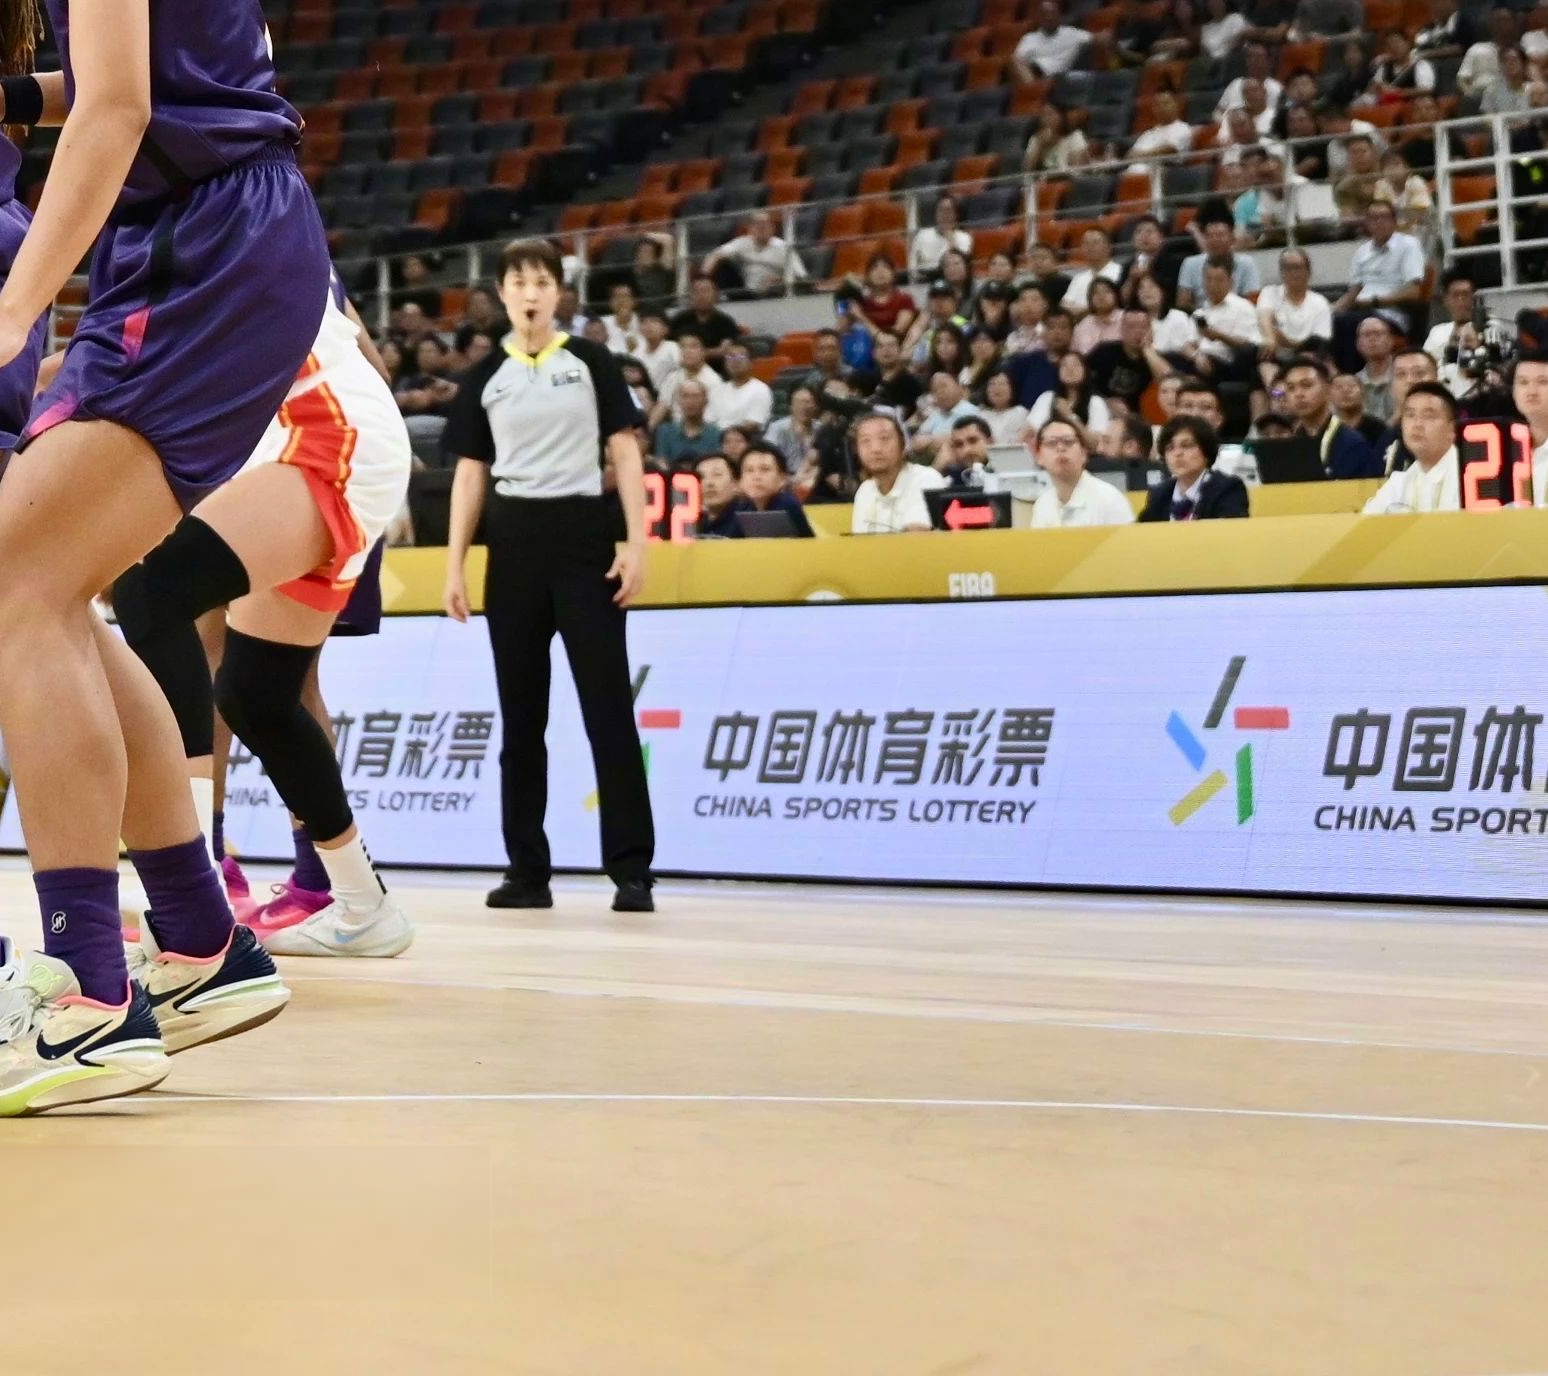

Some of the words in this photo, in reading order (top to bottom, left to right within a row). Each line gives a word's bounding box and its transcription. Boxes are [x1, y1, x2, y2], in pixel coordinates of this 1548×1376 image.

[705, 707, 1055, 789] 中国体育彩票
[376, 790, 478, 813] LOTTERY
[694, 795, 773, 818] CHINA
[783, 796, 899, 822] SPORTS
[908, 798, 1036, 824] LOTTERY
[1314, 805, 1417, 833] CHINA
